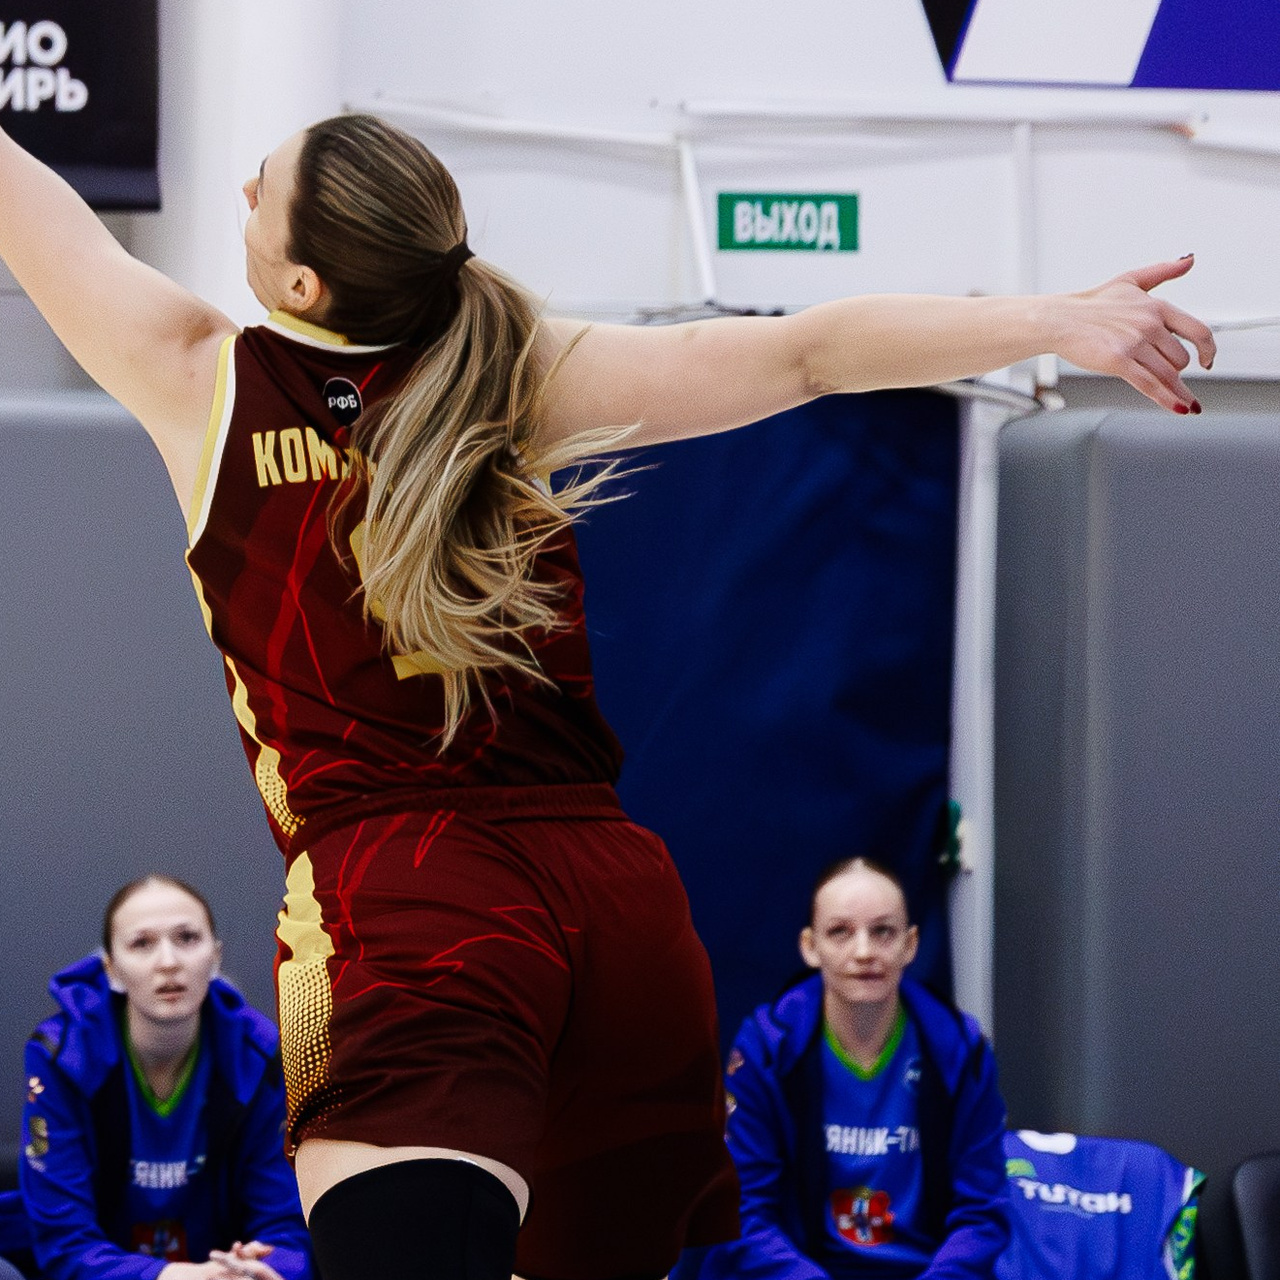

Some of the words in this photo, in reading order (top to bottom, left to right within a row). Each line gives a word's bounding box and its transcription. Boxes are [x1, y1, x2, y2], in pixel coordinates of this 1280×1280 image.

[732, 199, 841, 251] ВЫХОД
[327, 393, 358, 410] РФБ
[252, 426, 351, 489] КОМ
